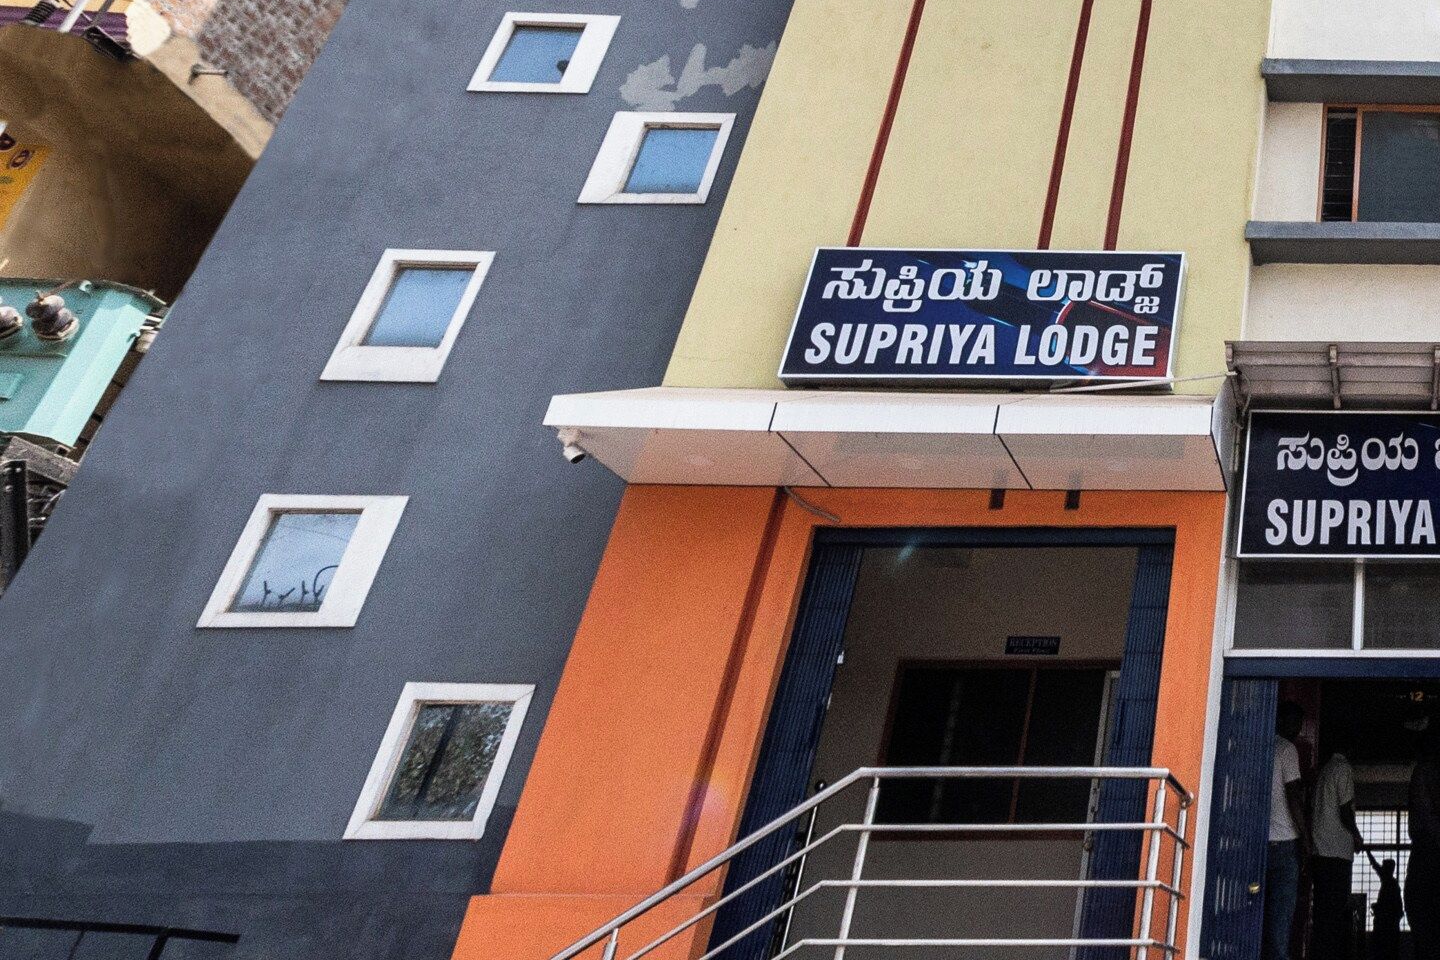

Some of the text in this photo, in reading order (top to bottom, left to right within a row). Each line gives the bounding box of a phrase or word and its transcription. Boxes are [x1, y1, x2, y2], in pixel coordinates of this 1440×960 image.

[821, 258, 1166, 314] ಸುಪ್ರಿಯ ಲಾಡ್ಜ್
[803, 321, 1160, 367] SUPRIYA LODGE
[1276, 430, 1420, 487] ಸುಪ್ರಿಯ
[1264, 497, 1437, 545] SUPRIYA
